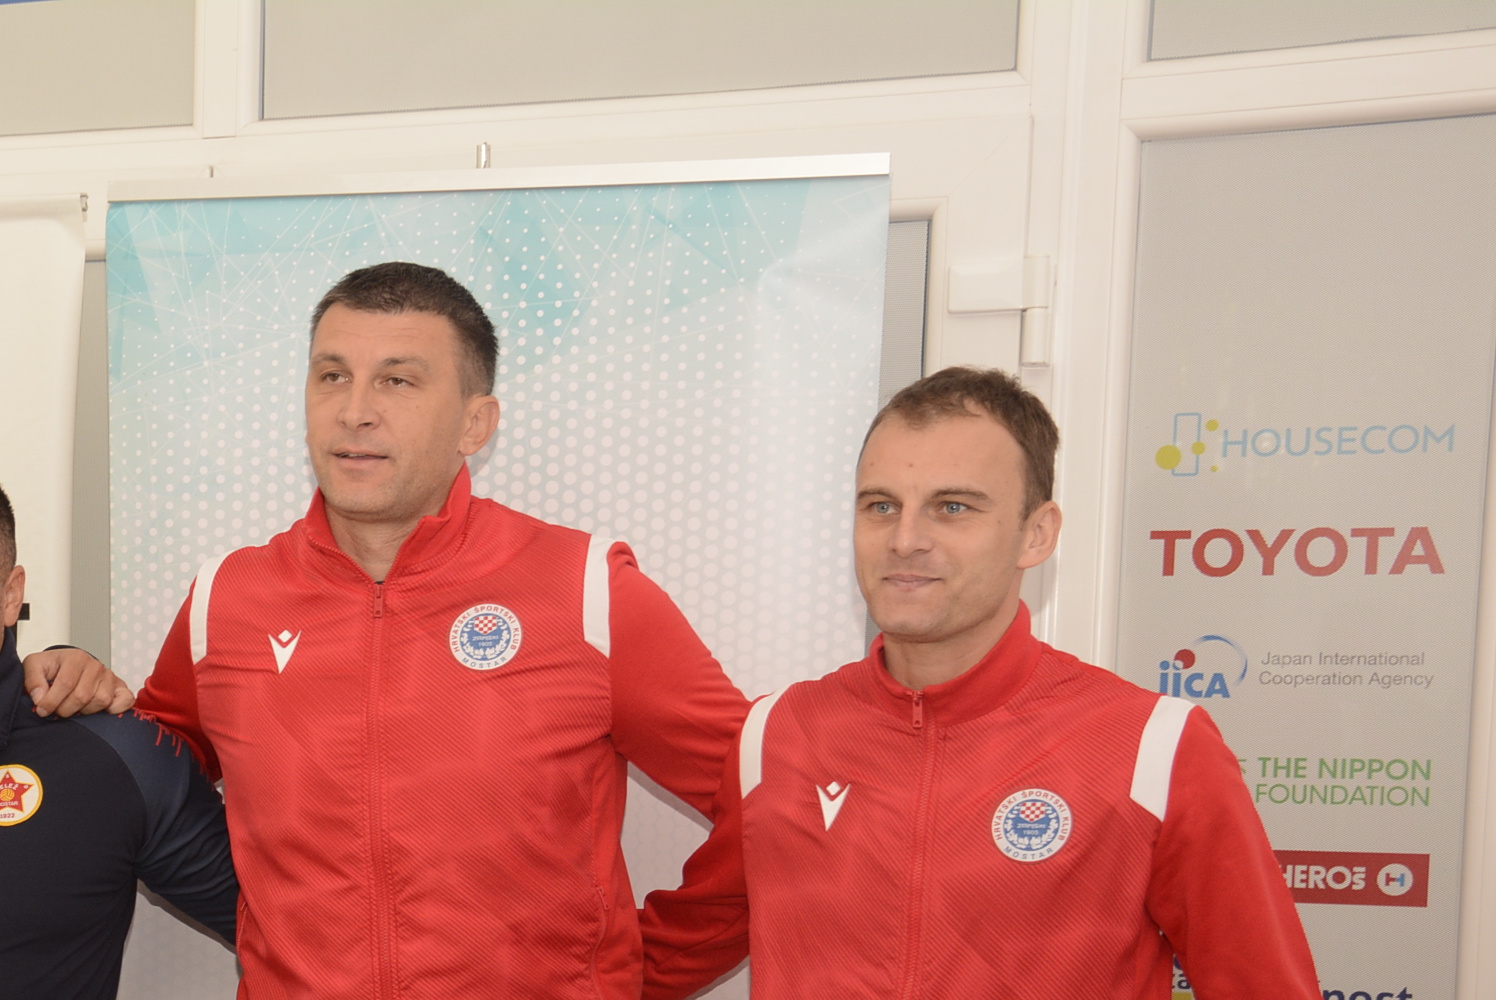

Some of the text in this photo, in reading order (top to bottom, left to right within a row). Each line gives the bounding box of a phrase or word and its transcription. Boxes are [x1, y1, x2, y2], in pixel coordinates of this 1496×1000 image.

[1221, 424, 1456, 458] HOUSECOM
[1149, 526, 1446, 577] TOYOTA
[451, 612, 471, 652] HRVATSKI
[510, 627, 520, 651] KLUB
[462, 656, 508, 669] MOSTAR
[1261, 652, 1426, 671] Japan International
[1259, 671, 1434, 689] Cooperation Agency
[1258, 757, 1307, 778] THE
[1318, 758, 1431, 780] NIPPON
[1255, 783, 1430, 806] FOUNDATION
[993, 796, 1017, 841] HRVATSKI
[1058, 816, 1070, 841] KLUB
[1004, 846, 1054, 860] MOSTAR
